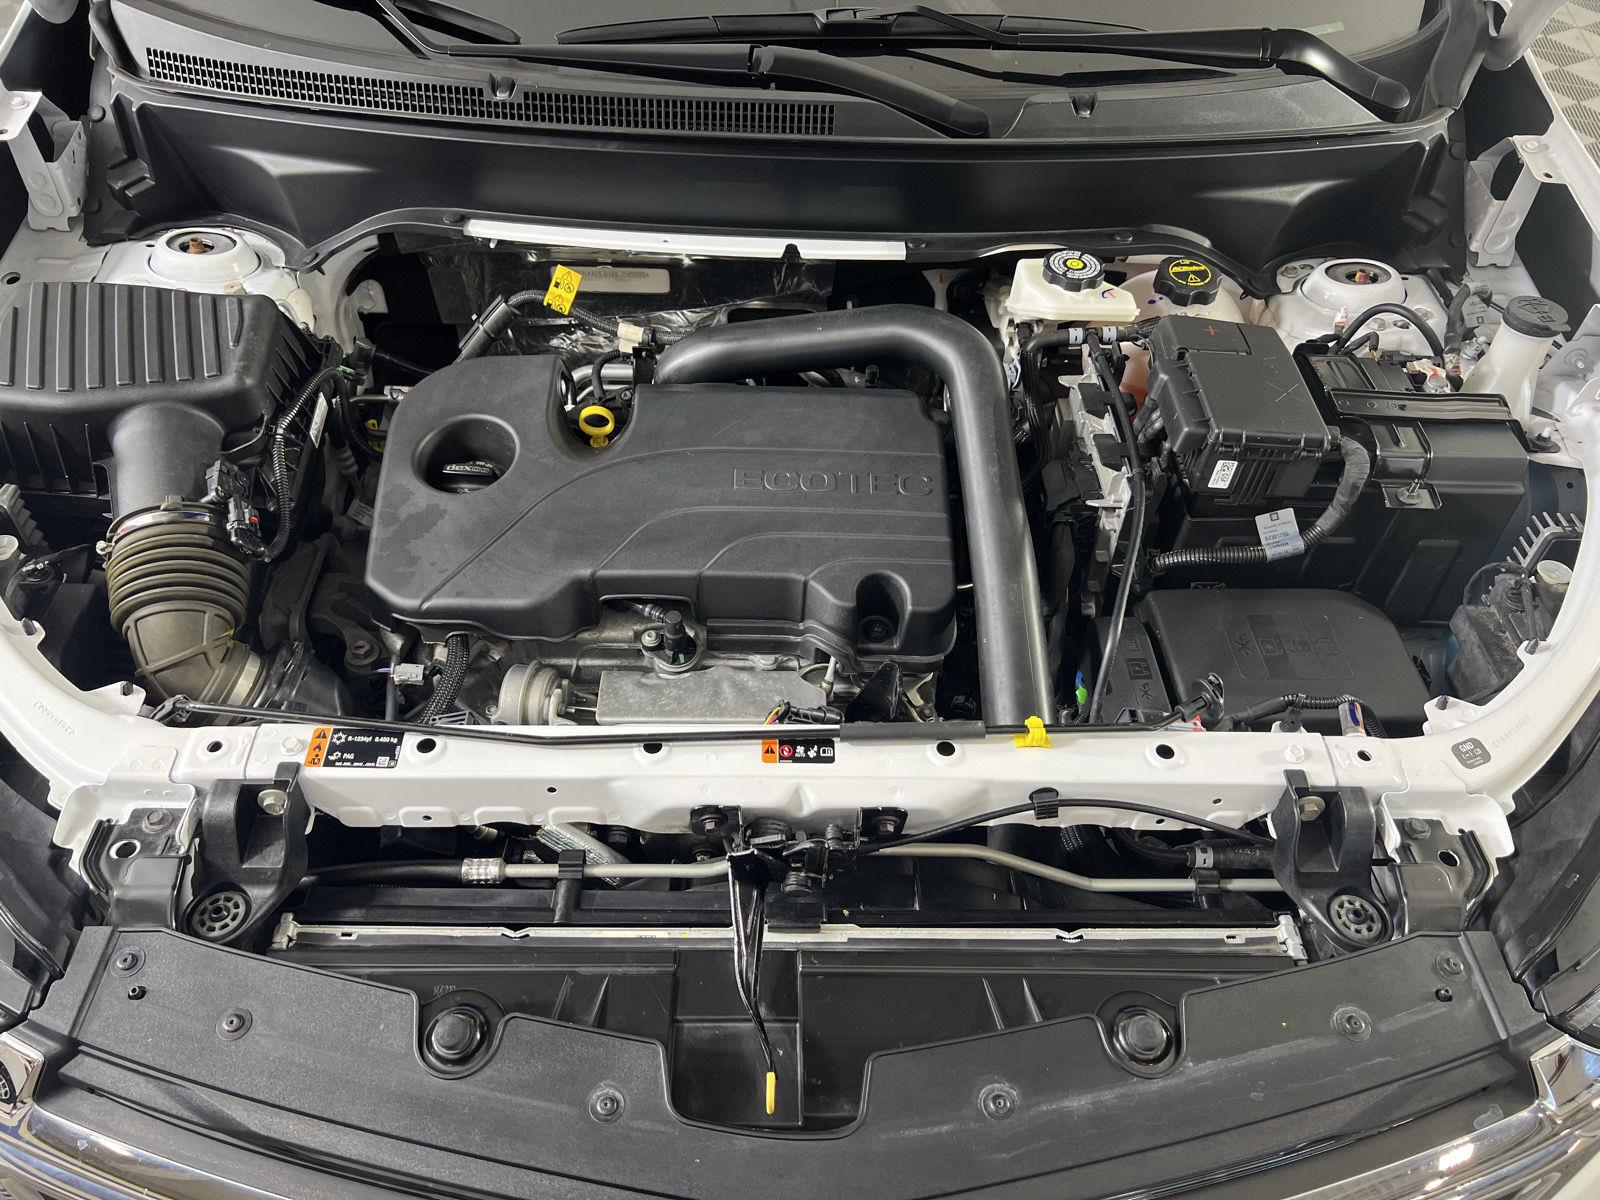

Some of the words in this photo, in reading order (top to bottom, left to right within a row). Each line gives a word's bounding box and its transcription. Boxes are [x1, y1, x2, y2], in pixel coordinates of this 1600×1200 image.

[733, 468, 933, 496] ECOTEC
[1459, 741, 1475, 752] GND
[342, 752, 355, 760] PAG
